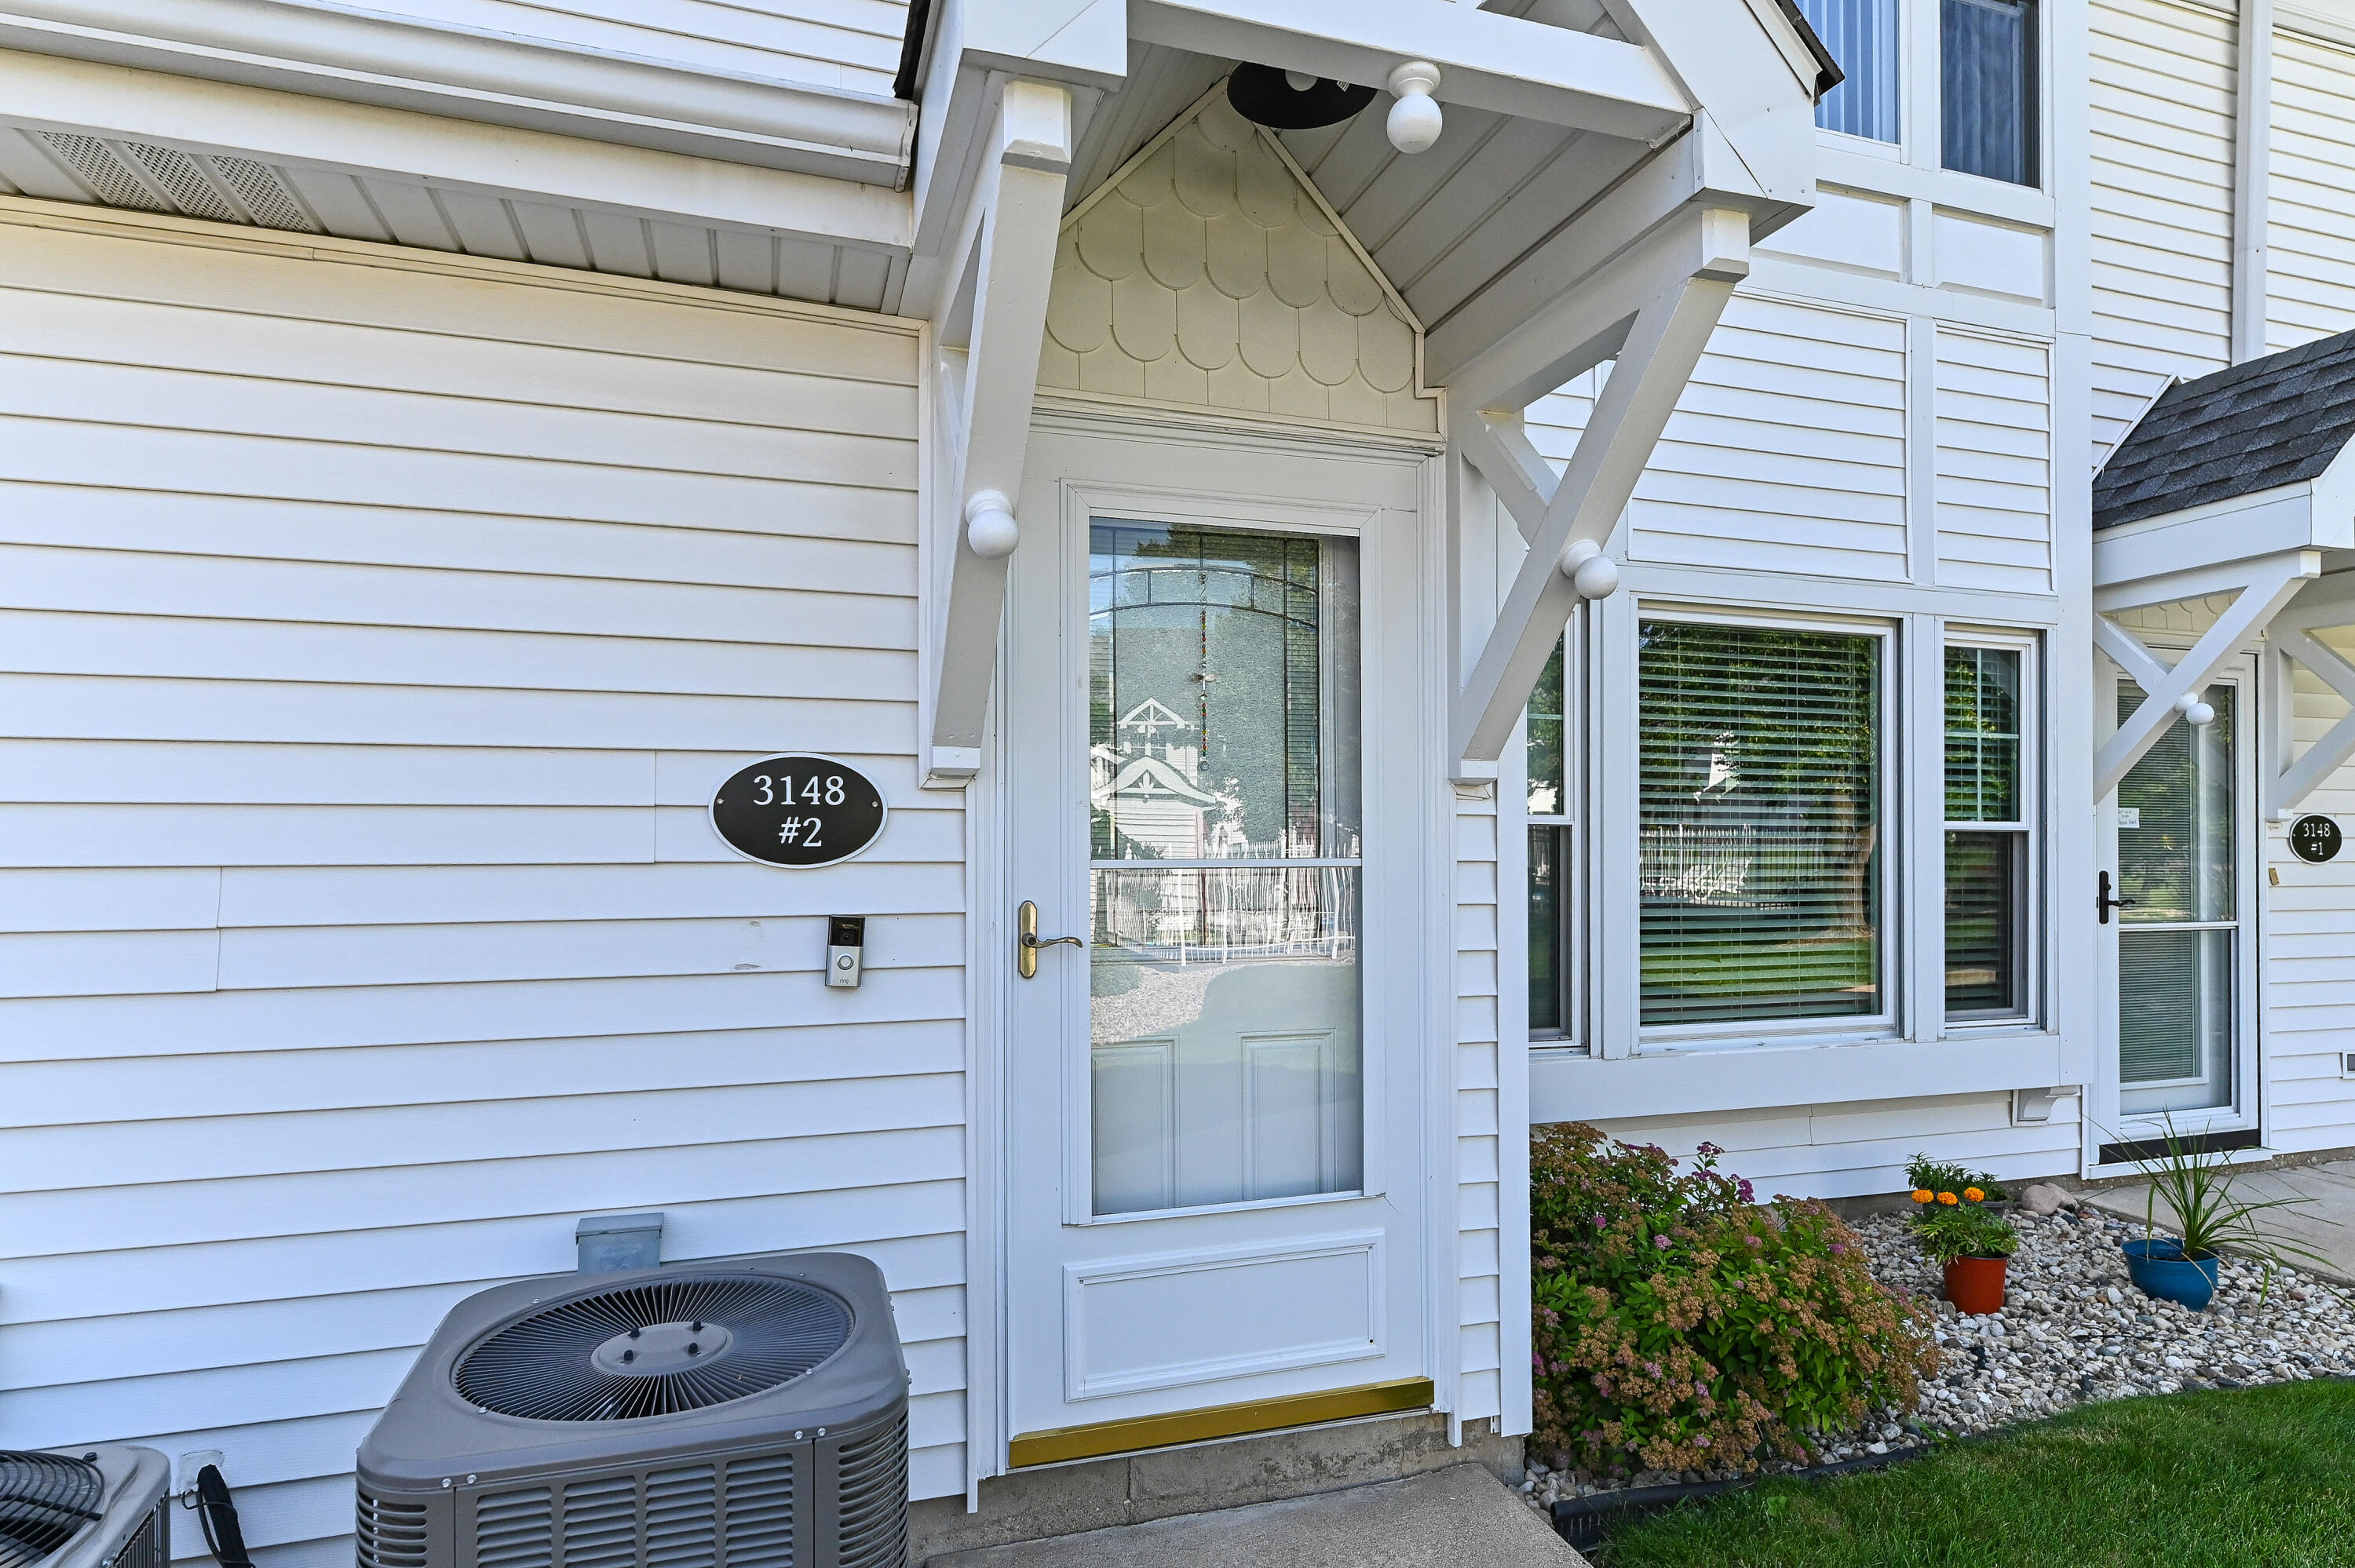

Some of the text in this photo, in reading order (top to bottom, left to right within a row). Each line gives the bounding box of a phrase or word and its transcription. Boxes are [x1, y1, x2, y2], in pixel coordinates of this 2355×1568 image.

[753, 775, 845, 806] 3148
[778, 816, 822, 848] #2
[2303, 822, 2331, 837] 3148
[2310, 841, 2324, 855] #1
